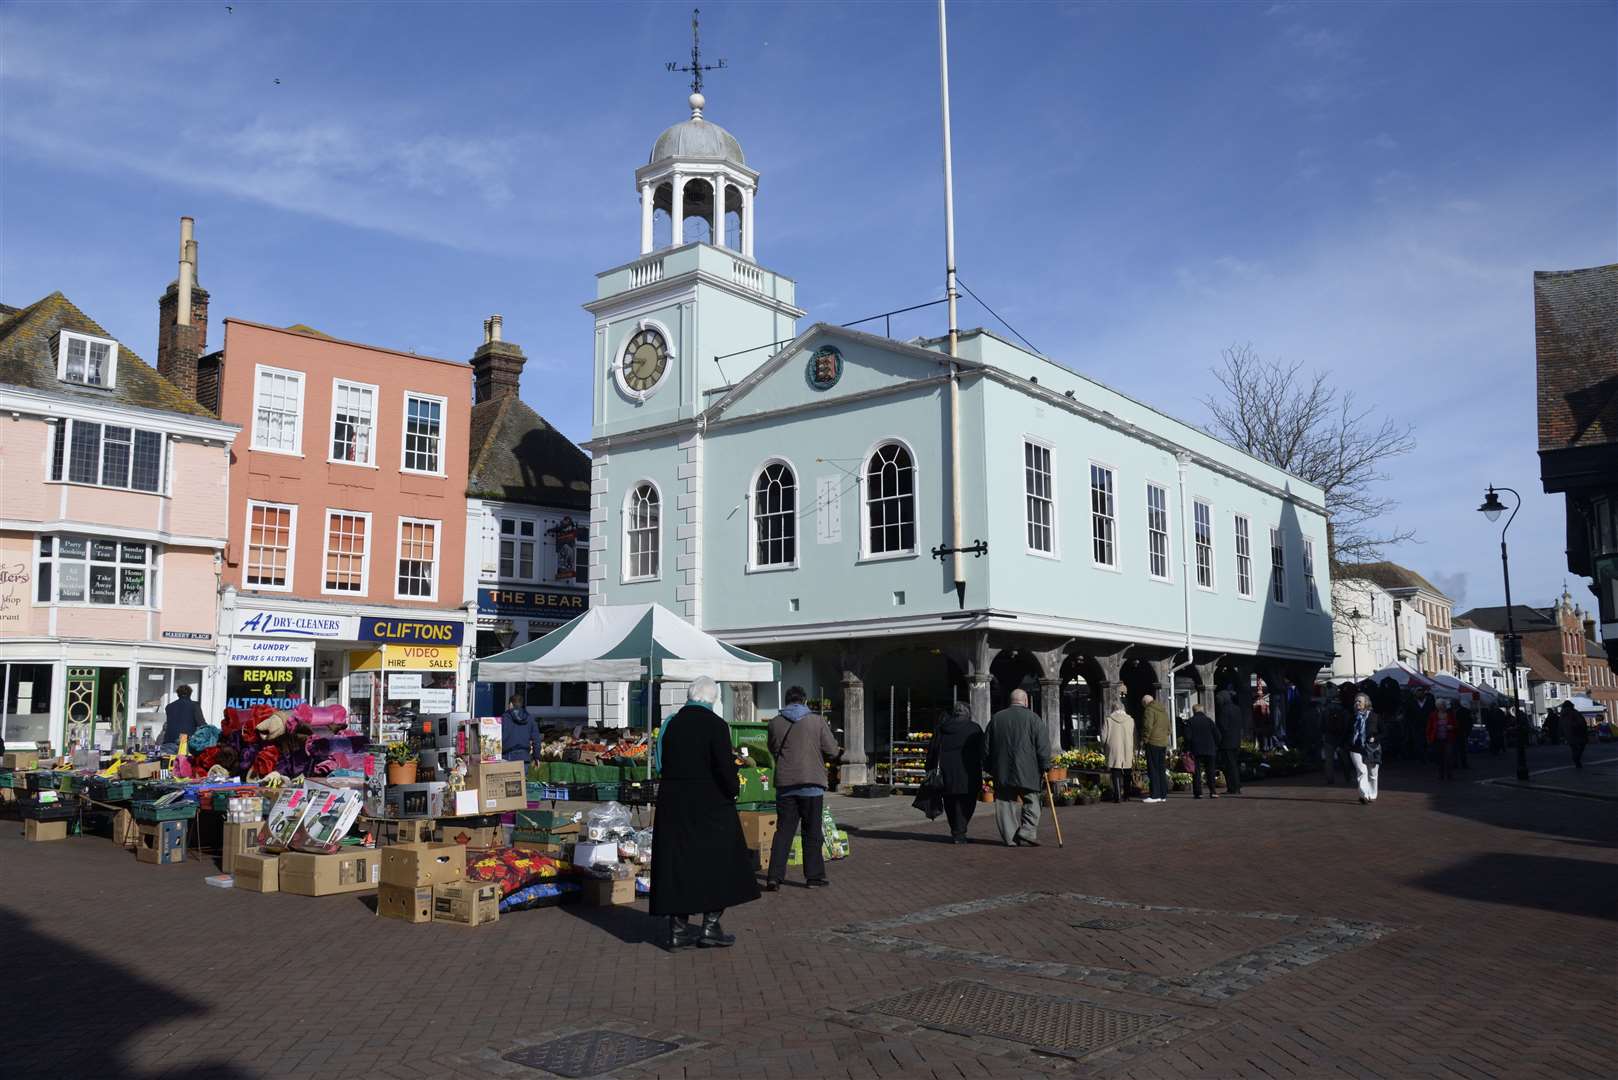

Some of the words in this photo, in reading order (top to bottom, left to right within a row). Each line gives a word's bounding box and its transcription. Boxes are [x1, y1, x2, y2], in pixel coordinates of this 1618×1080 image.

[489, 590, 526, 604] THE
[534, 593, 583, 608] BEAR
[273, 616, 340, 631] DRY-CLEANERS
[374, 622, 453, 640] CLIFTONS
[252, 643, 290, 652] LAUNDRY
[404, 648, 439, 658] VIDEO
[231, 654, 259, 662] REPAIRS
[266, 655, 309, 663] ALTERATIONS
[388, 659, 406, 667] HIRE
[429, 660, 453, 668] SALES
[243, 669, 293, 682] REPAIRS
[263, 684, 272, 696] &
